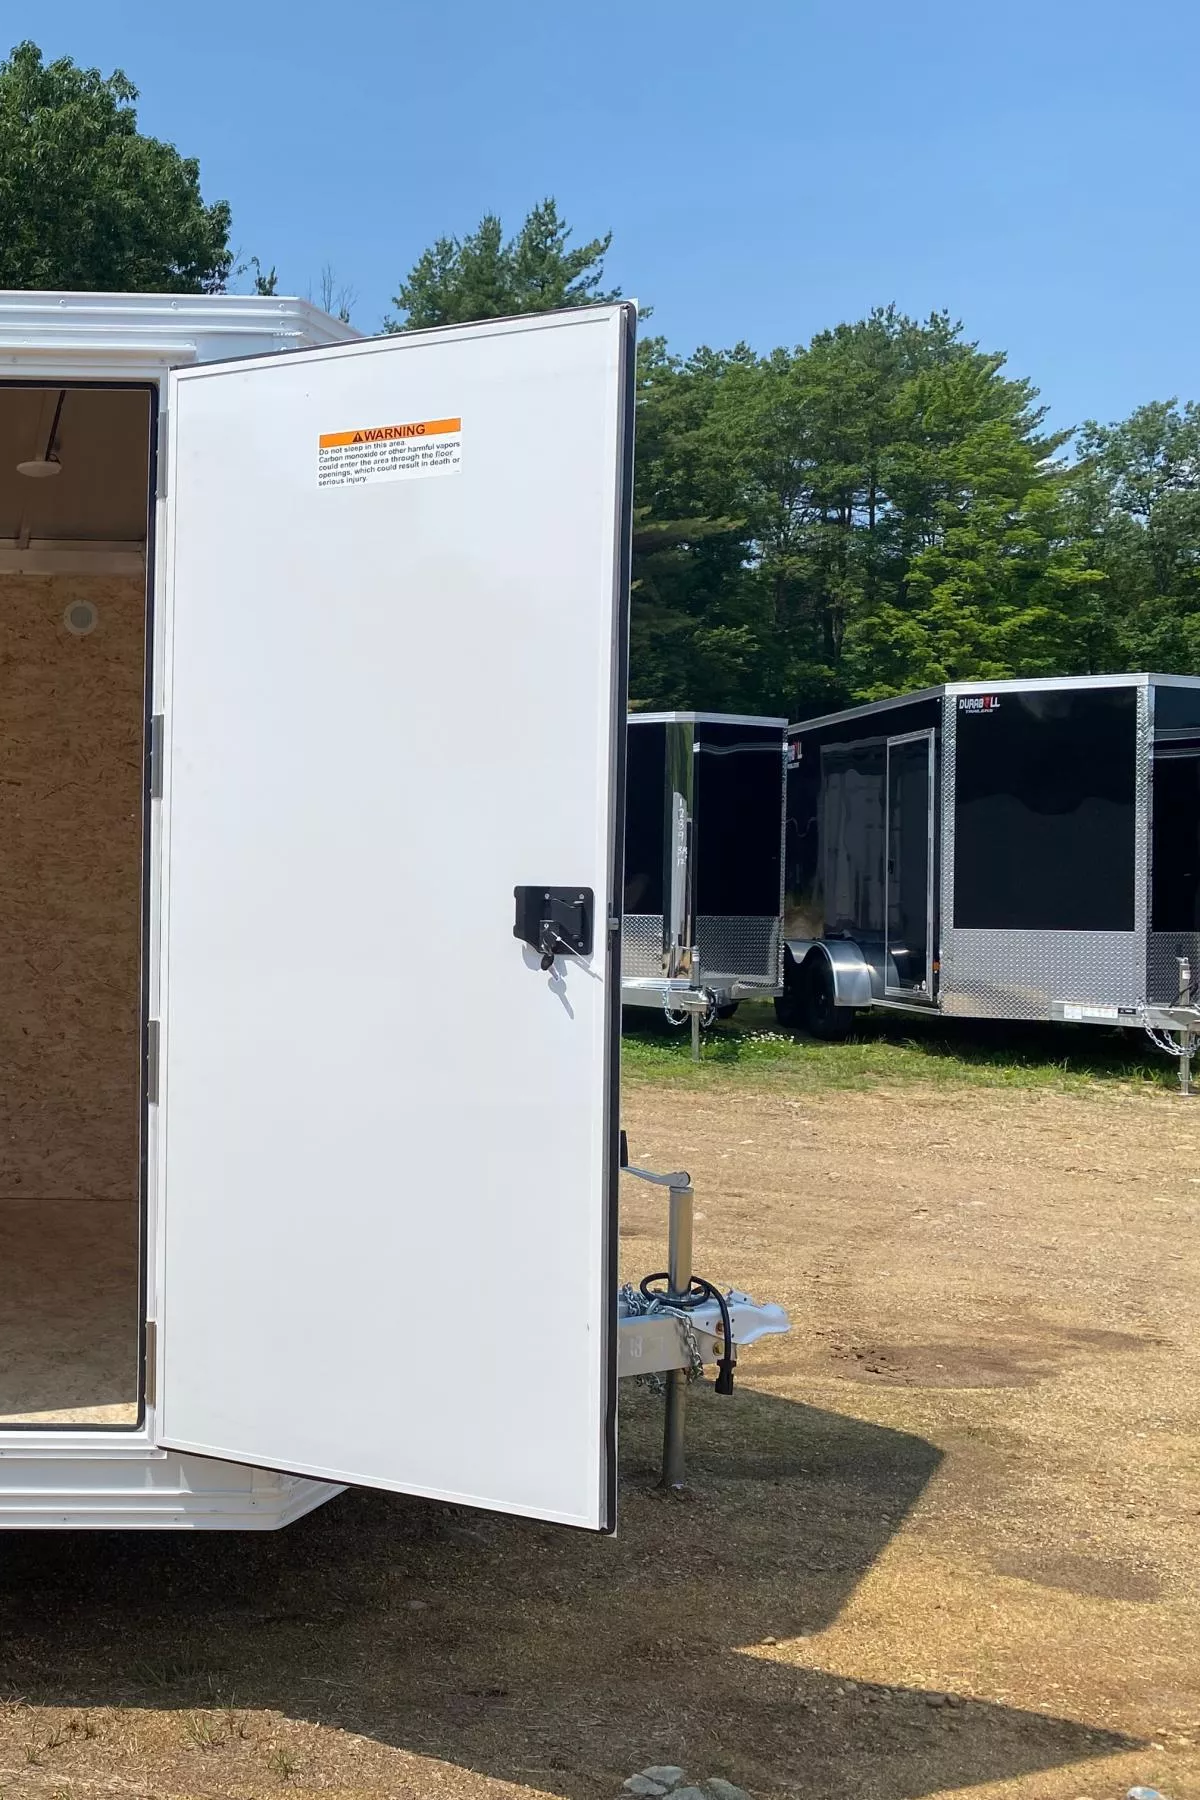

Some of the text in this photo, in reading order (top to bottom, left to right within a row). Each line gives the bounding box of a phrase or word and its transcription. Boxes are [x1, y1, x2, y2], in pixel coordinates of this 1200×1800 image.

[364, 425, 425, 441] WARNING
[319, 455, 343, 463] Carbon
[345, 451, 378, 460] monoxide
[388, 447, 406, 455] other
[408, 443, 434, 453] harmful
[436, 441, 460, 450] vapors
[319, 463, 338, 471] could
[391, 454, 420, 462] through
[435, 450, 453, 458] floor
[318, 470, 352, 479] openings,
[354, 466, 375, 475] which
[377, 463, 397, 472] could
[398, 461, 420, 469] result
[430, 458, 450, 466] death
[318, 478, 345, 486] serious
